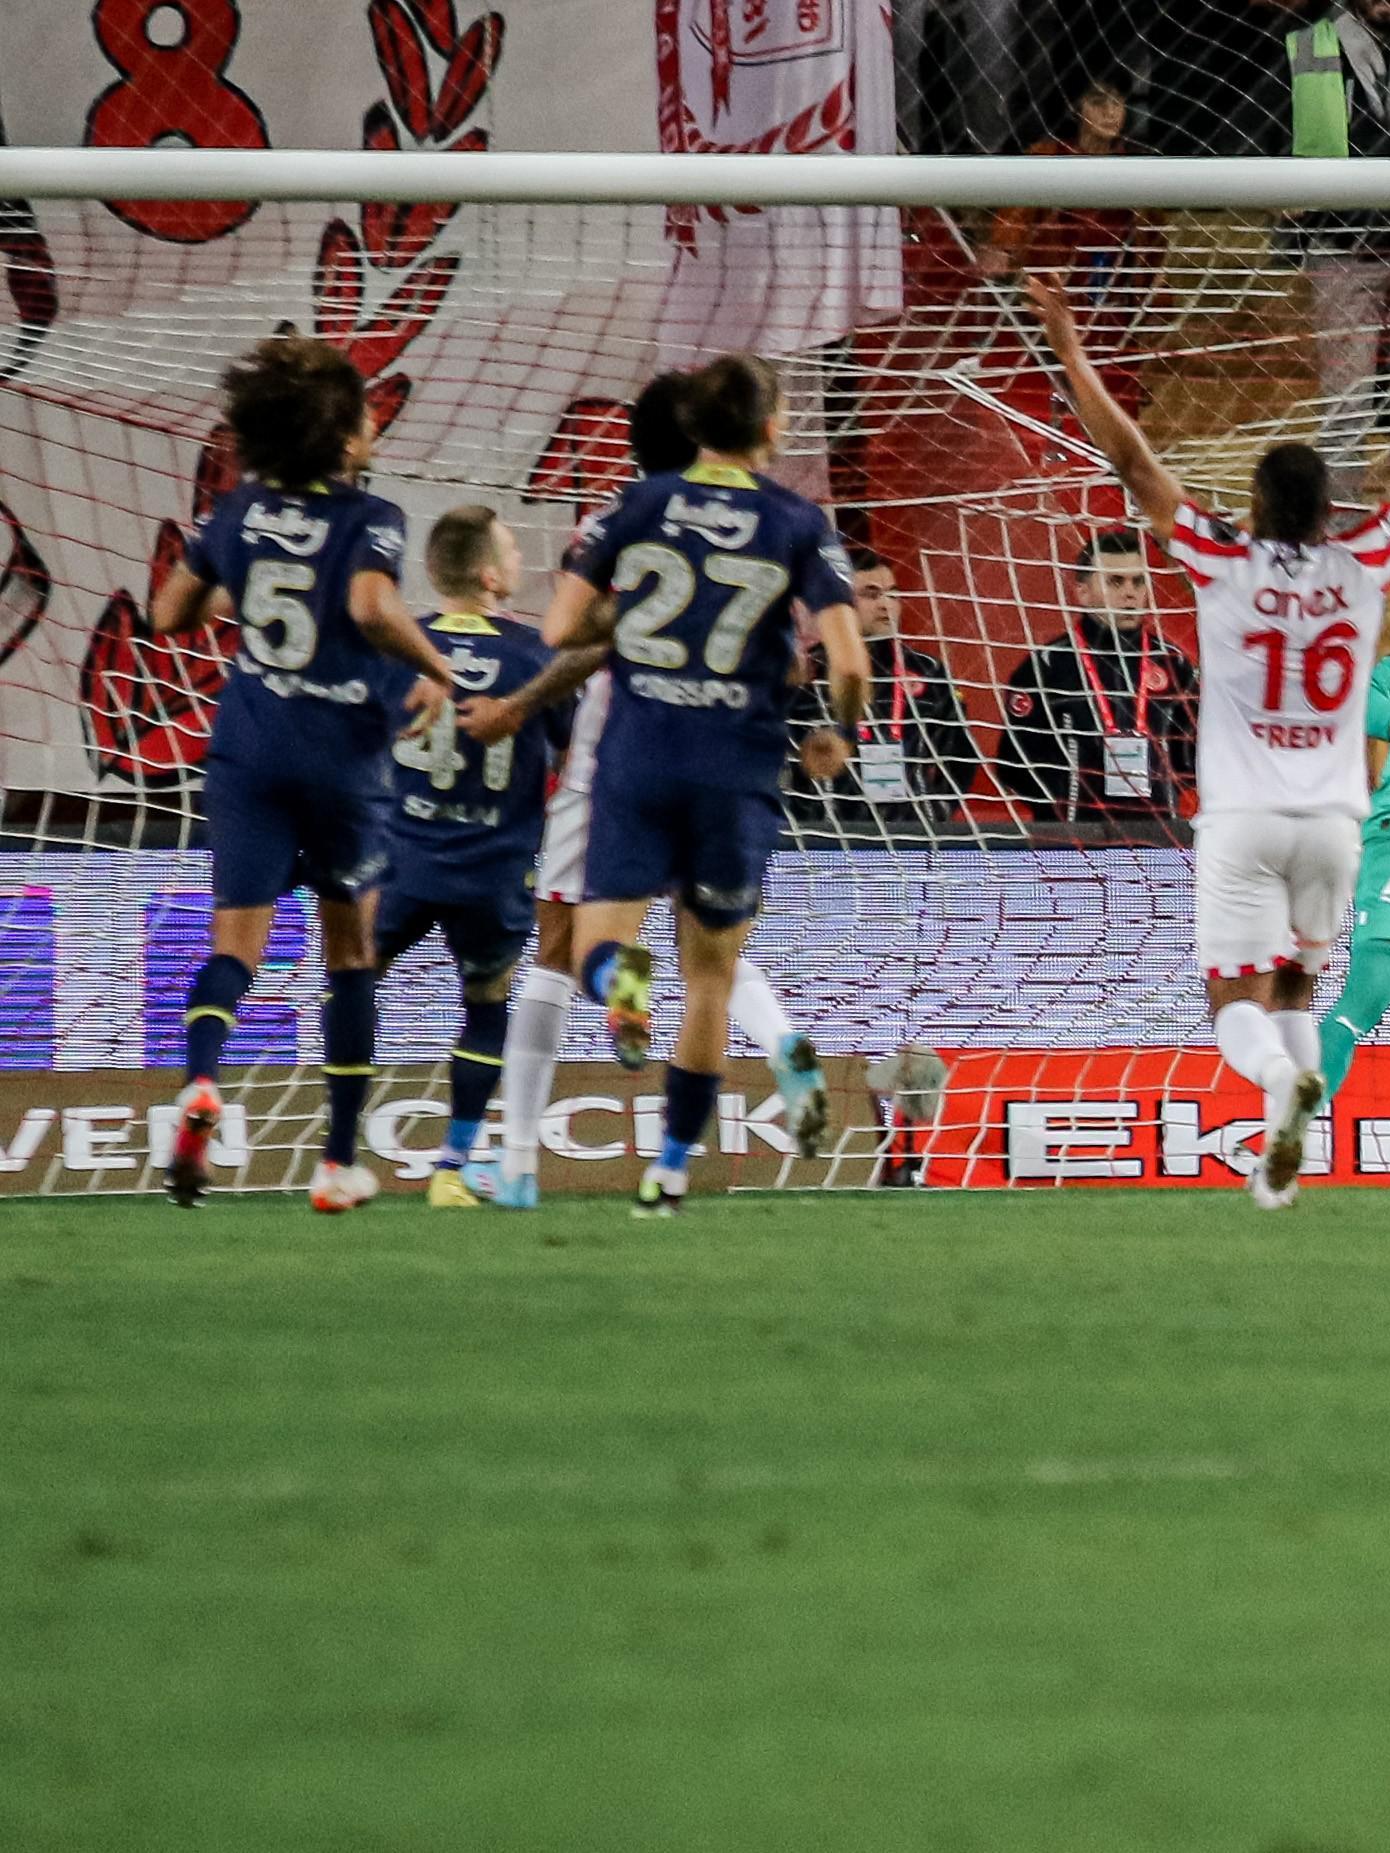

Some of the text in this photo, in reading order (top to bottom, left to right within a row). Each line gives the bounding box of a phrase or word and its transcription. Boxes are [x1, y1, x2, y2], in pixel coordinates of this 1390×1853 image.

[242, 560, 317, 671] 5
[612, 541, 790, 675] 27
[1243, 620, 1359, 713] 16
